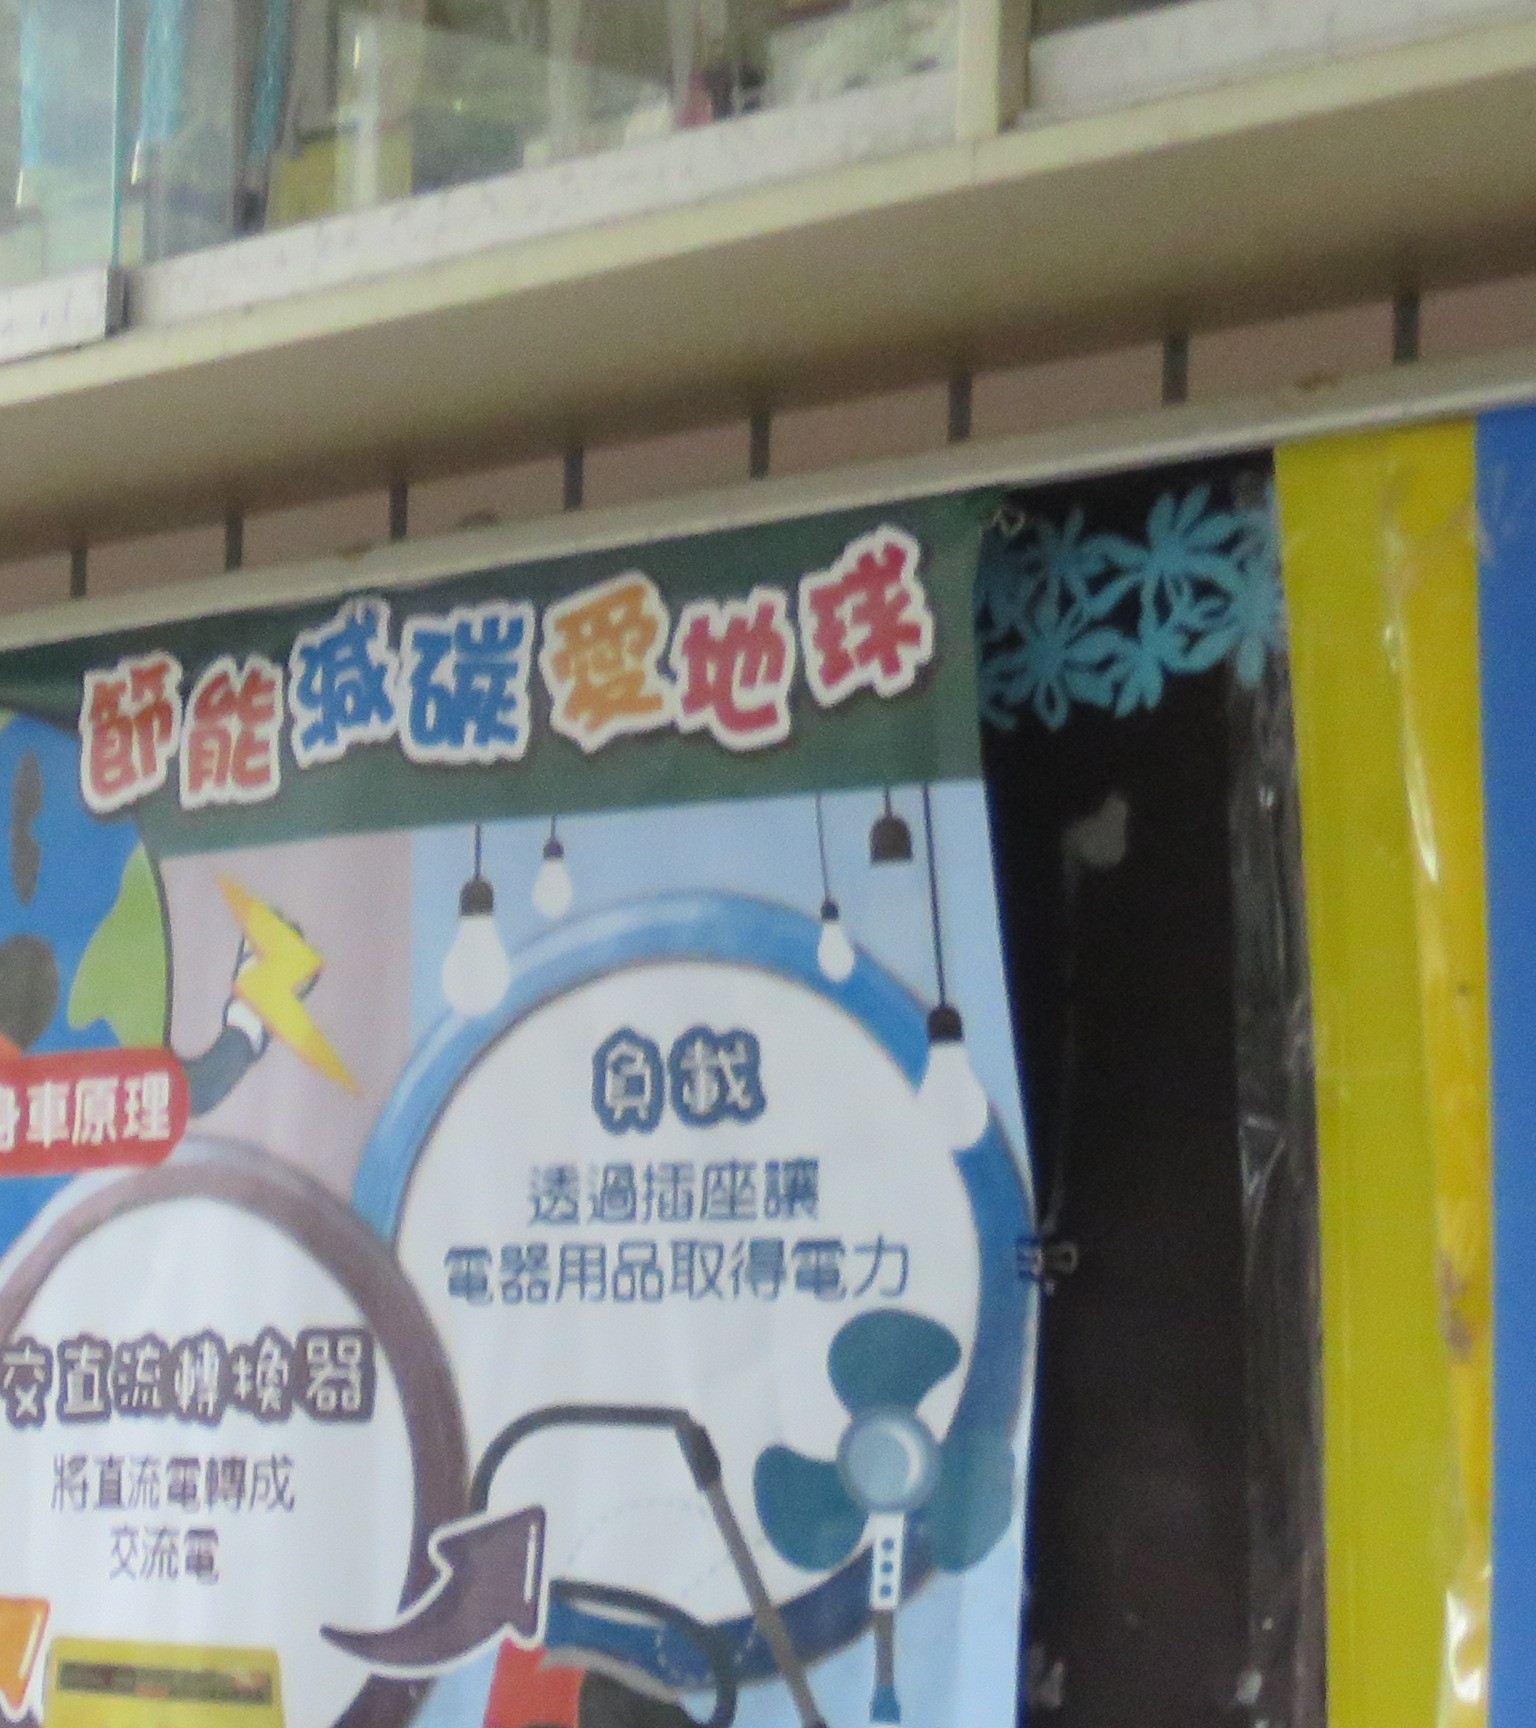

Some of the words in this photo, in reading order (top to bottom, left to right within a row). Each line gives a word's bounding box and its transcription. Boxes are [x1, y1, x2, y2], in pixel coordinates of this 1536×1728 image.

[80, 524, 932, 814] 節能減碳愛地球
[591, 1024, 766, 1134] 負載
[528, 1156, 819, 1224] 透過插座讓
[444, 1234, 911, 1305] 電器用品取得電力
[50, 1452, 297, 1514] 將直流電轉成
[108, 1524, 221, 1585] 交流電
